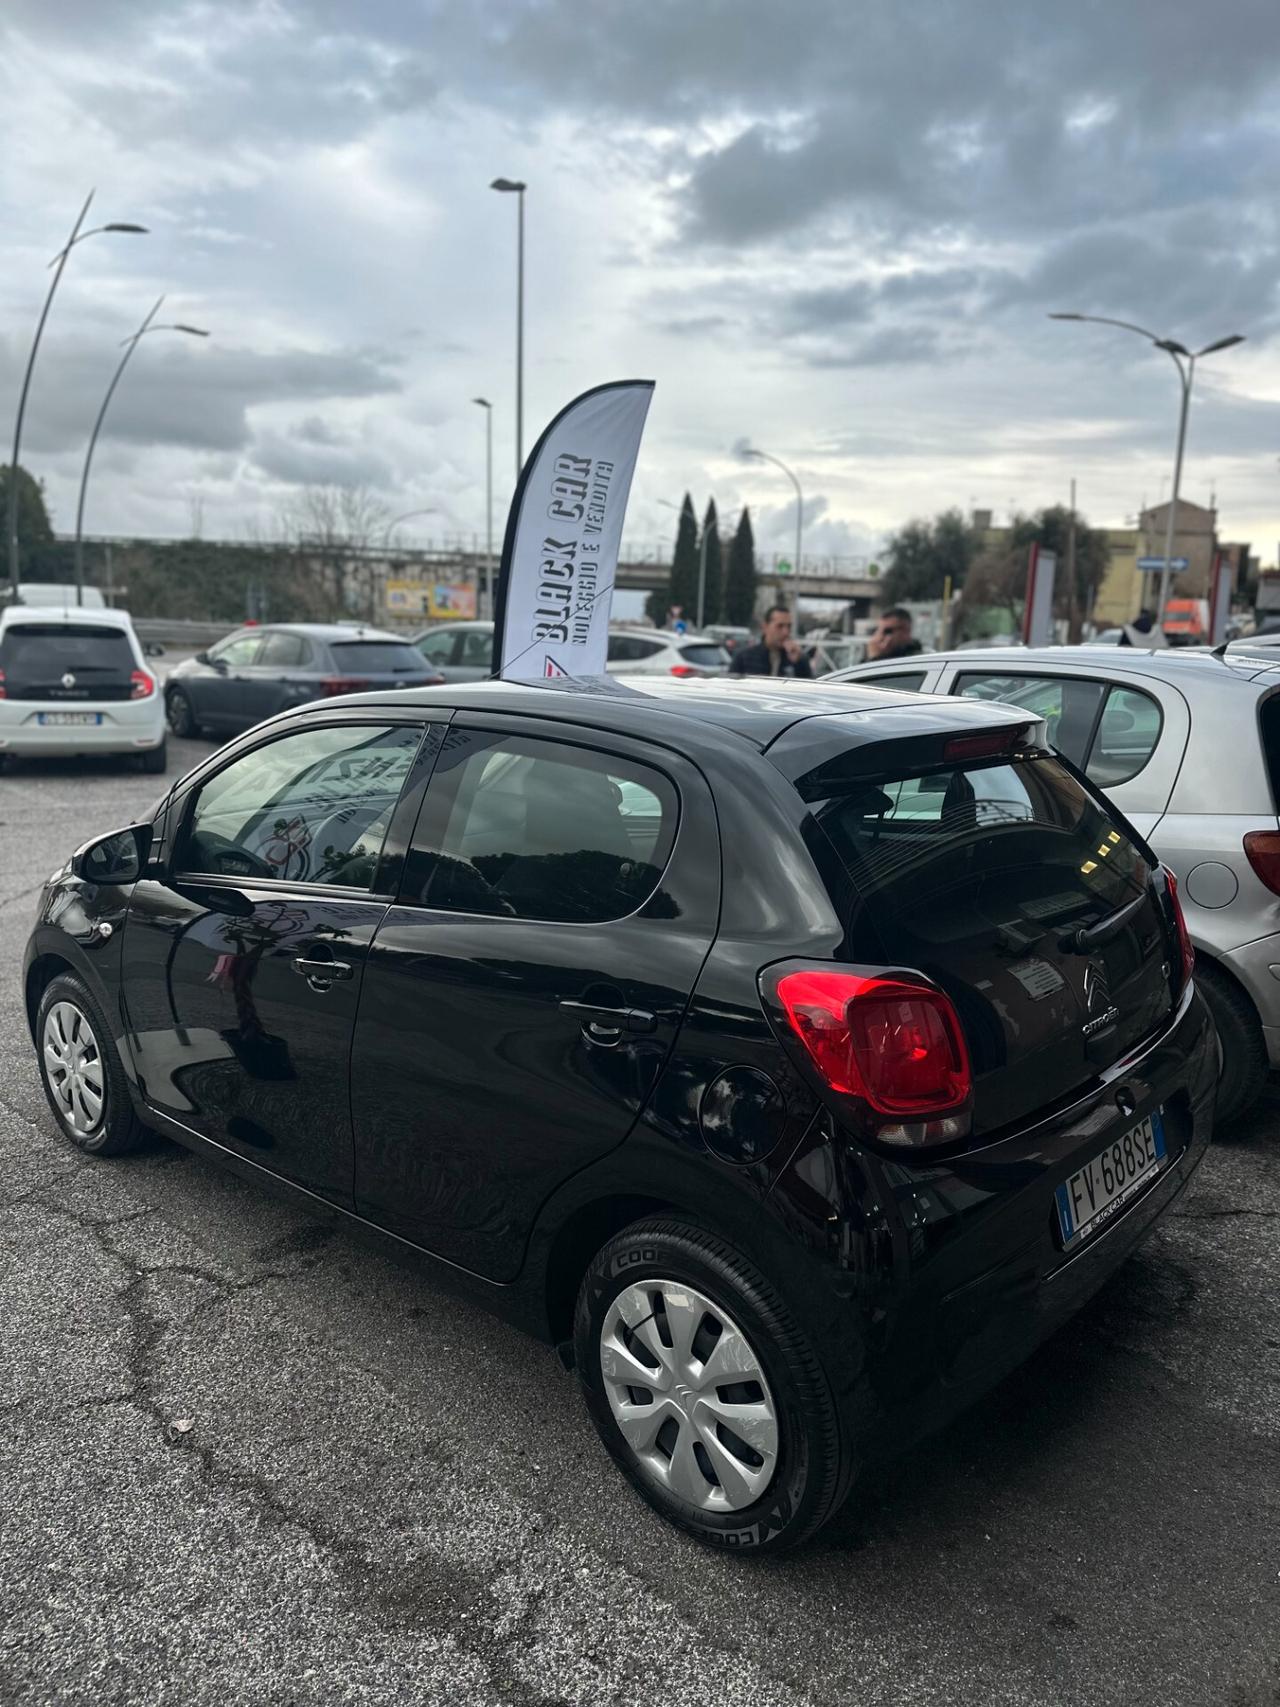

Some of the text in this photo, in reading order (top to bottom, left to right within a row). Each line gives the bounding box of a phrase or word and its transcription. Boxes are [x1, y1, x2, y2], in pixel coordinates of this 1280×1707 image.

[532, 452, 592, 644] BLACK CAR
[573, 461, 614, 645] NOLEGGIO E VENDITA
